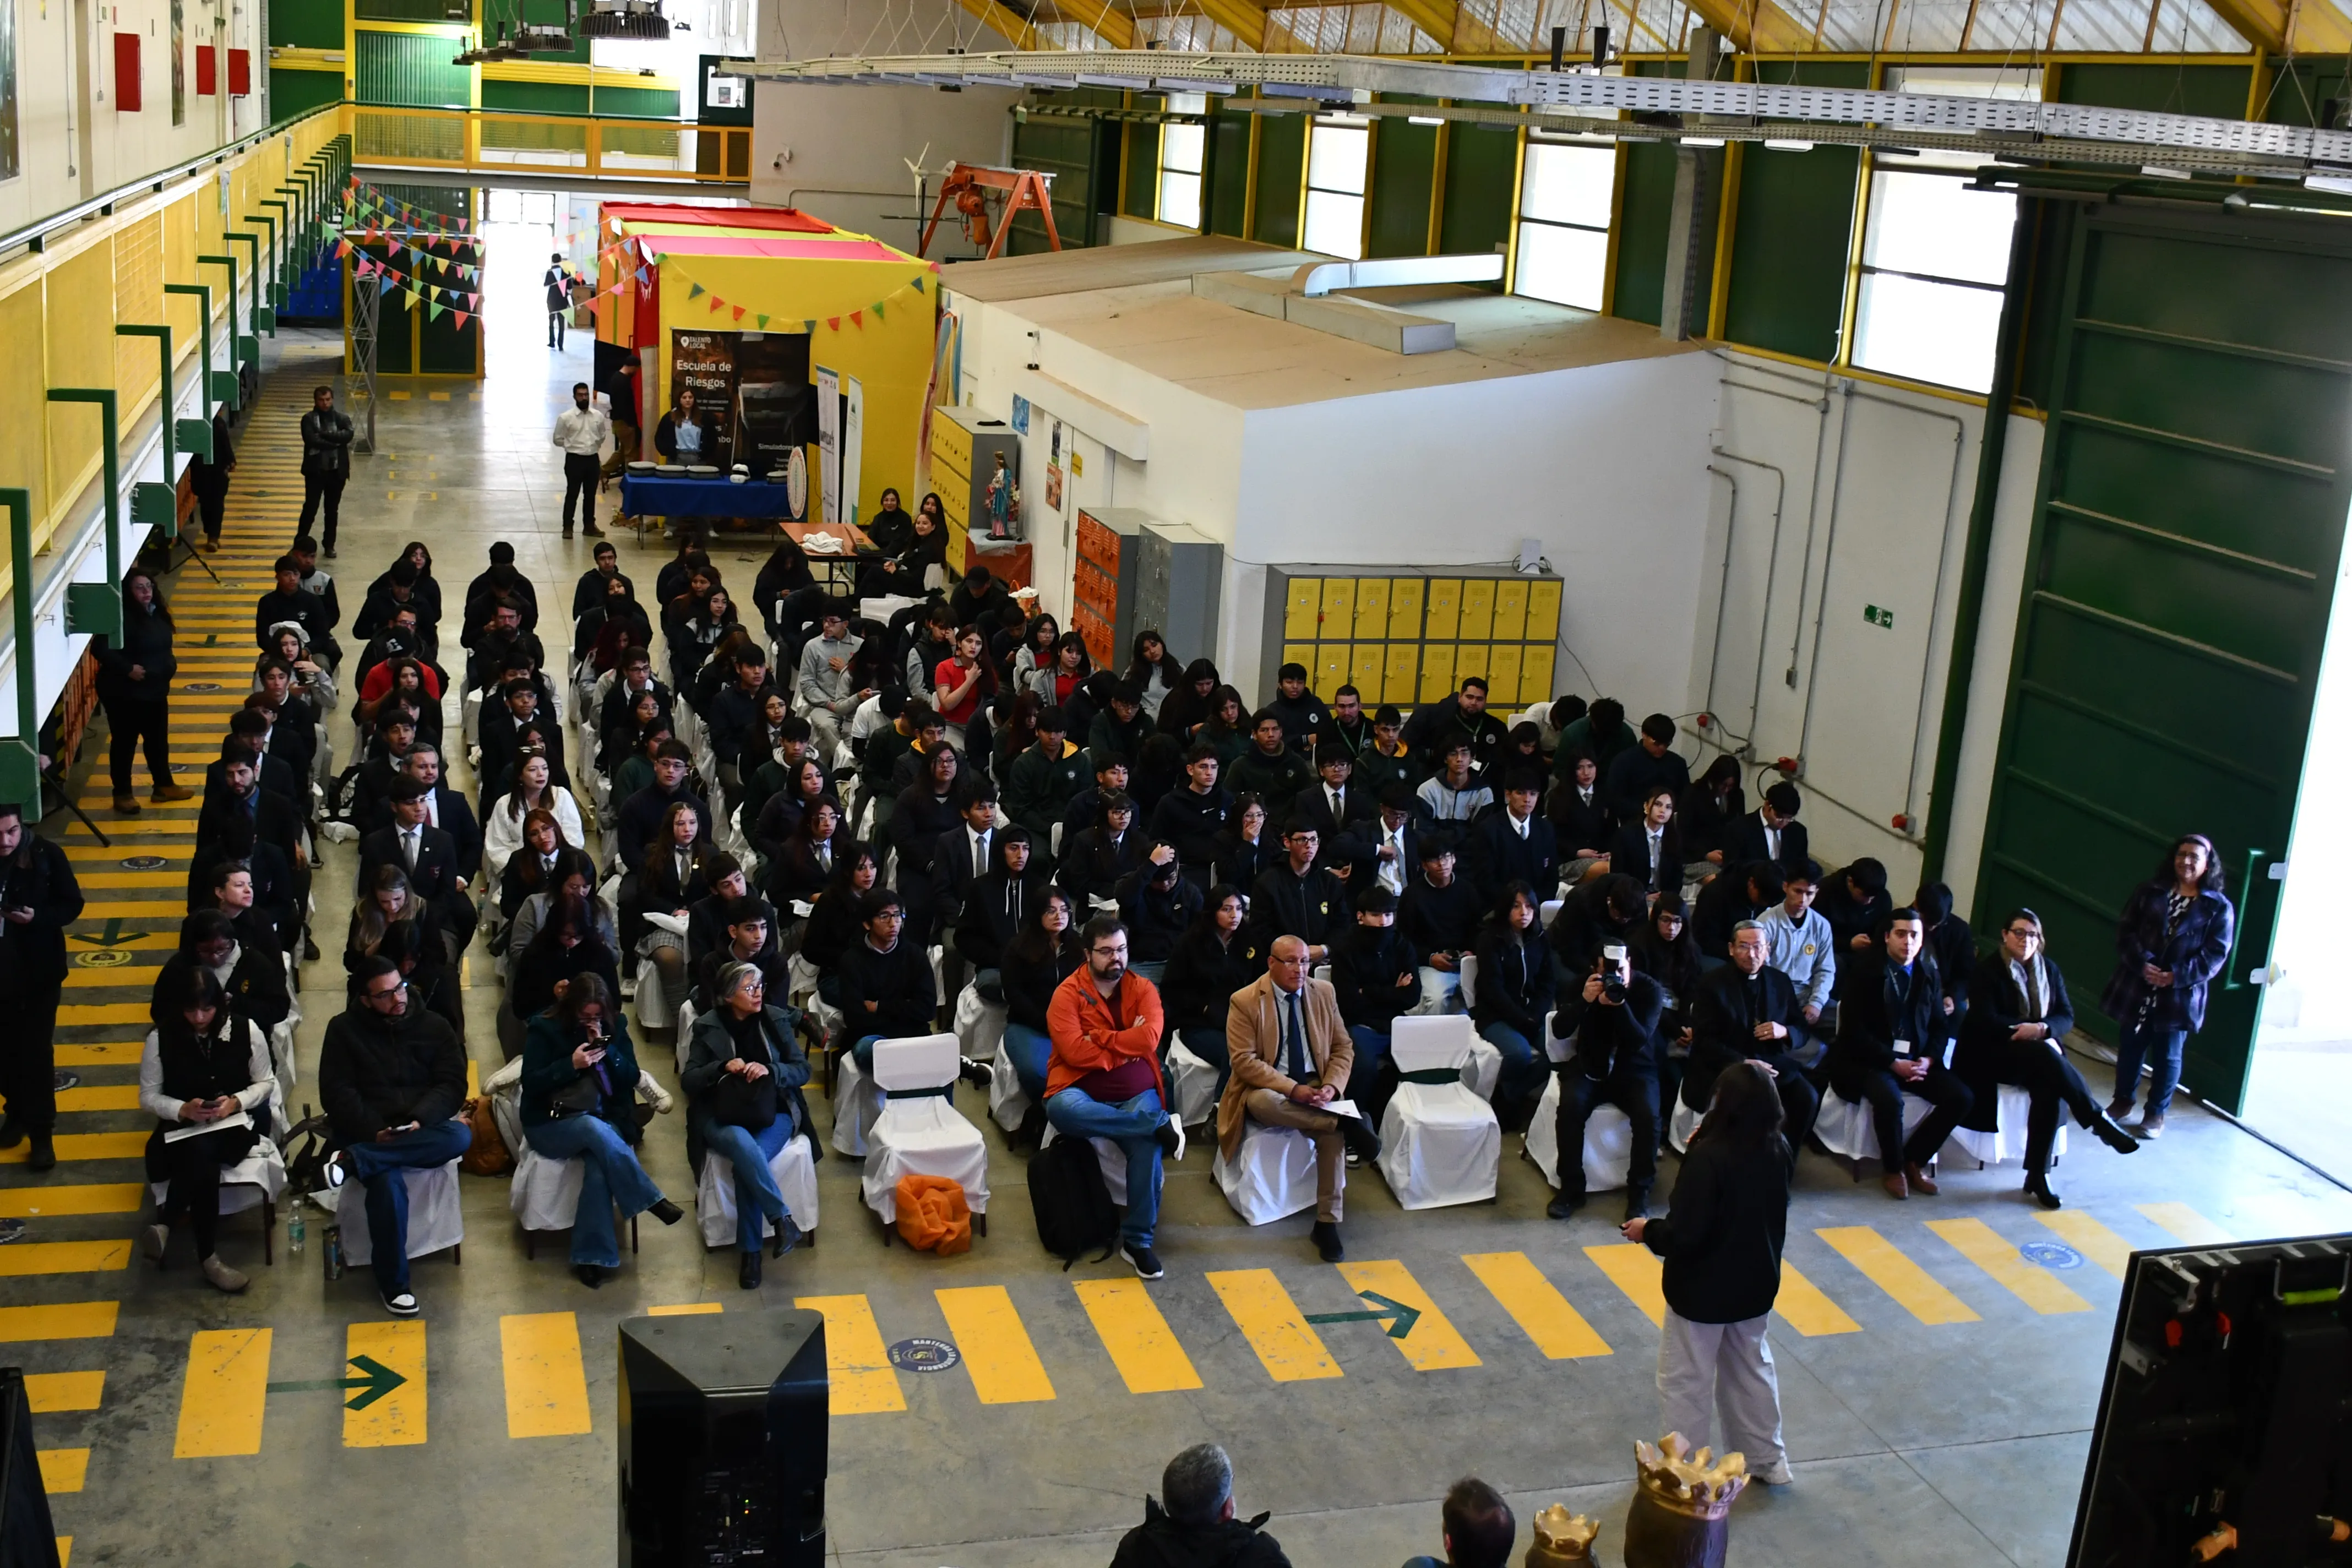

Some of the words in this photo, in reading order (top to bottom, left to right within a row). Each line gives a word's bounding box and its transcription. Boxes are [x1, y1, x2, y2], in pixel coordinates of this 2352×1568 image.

[677, 360, 716, 371] Escuela
[718, 361, 732, 372] de
[685, 376, 726, 390] Riesgos
[912, 1340, 953, 1352] MANTENGA
